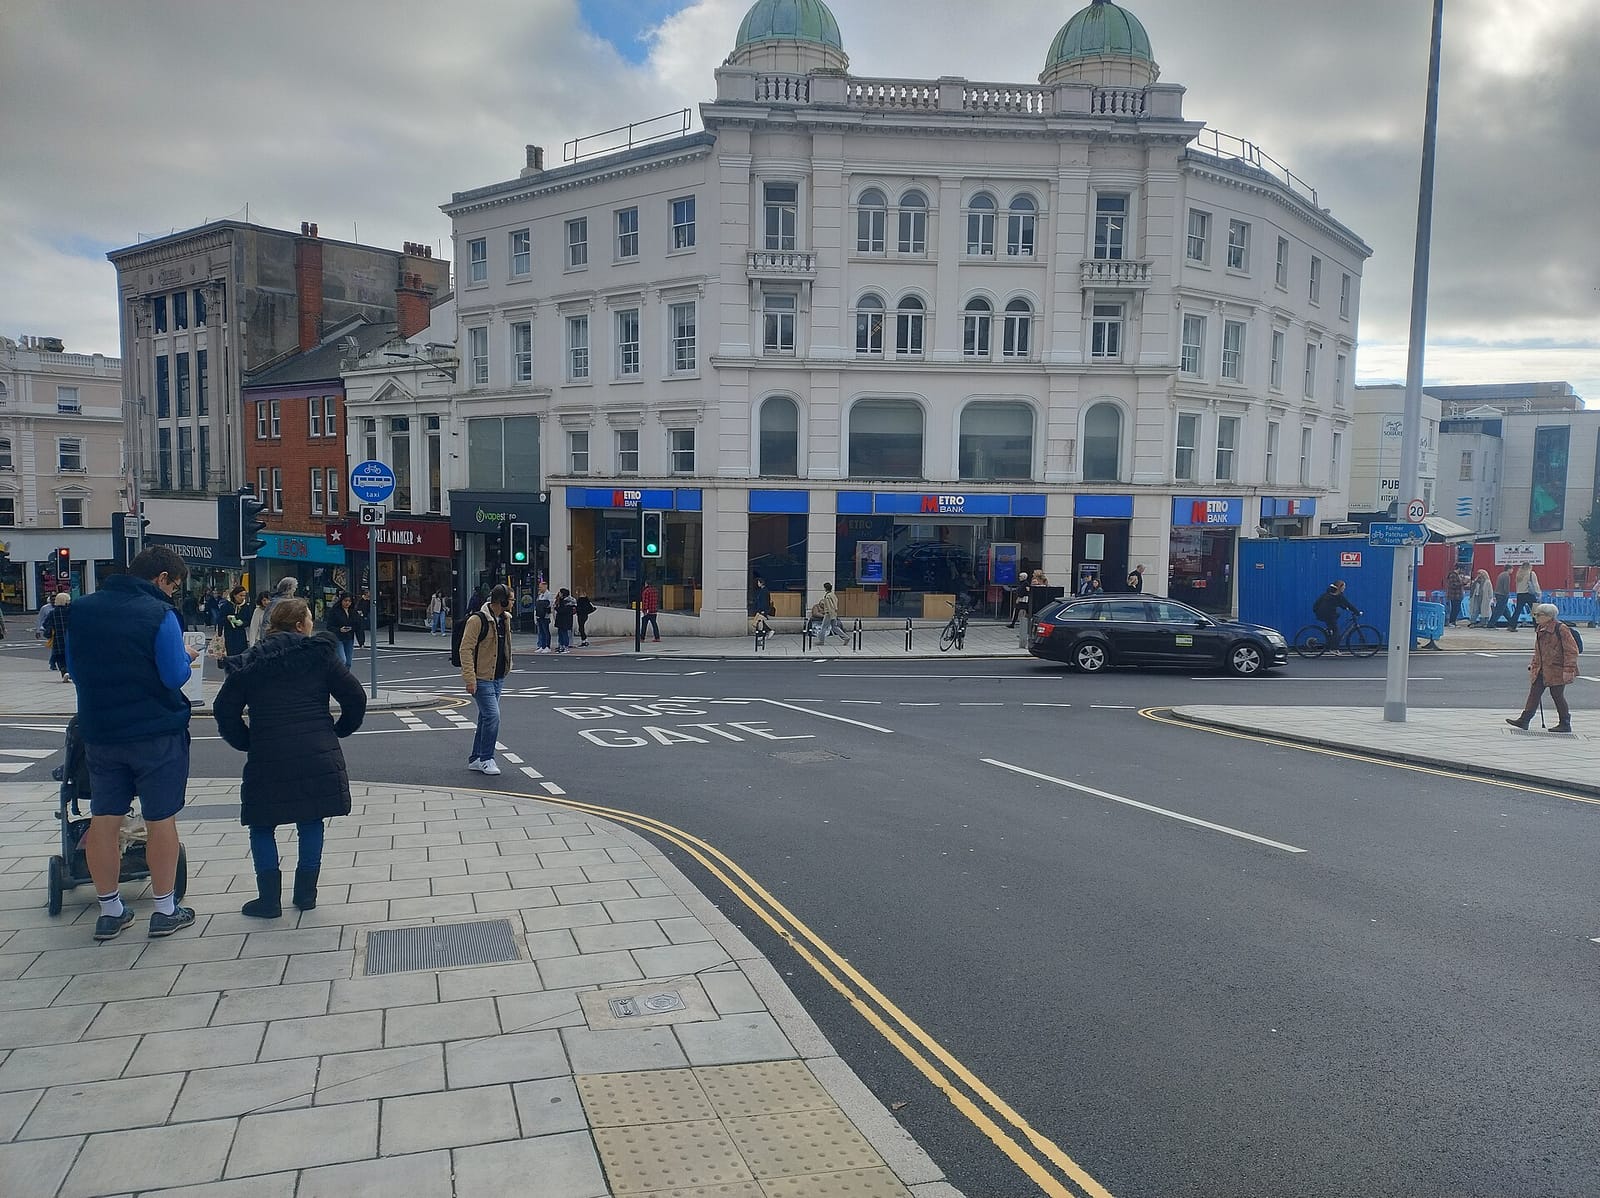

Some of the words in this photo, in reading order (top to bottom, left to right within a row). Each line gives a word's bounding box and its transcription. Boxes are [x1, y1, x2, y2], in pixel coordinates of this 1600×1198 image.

[613, 490, 642, 507] METRO
[921, 496, 965, 513] METRO
[1191, 501, 1229, 524] METRO
[1207, 514, 1228, 523] BANK
[1410, 506, 1424, 517] 20
[277, 539, 308, 558] LEON
[552, 703, 708, 720] BUS
[577, 721, 817, 748] GATE
